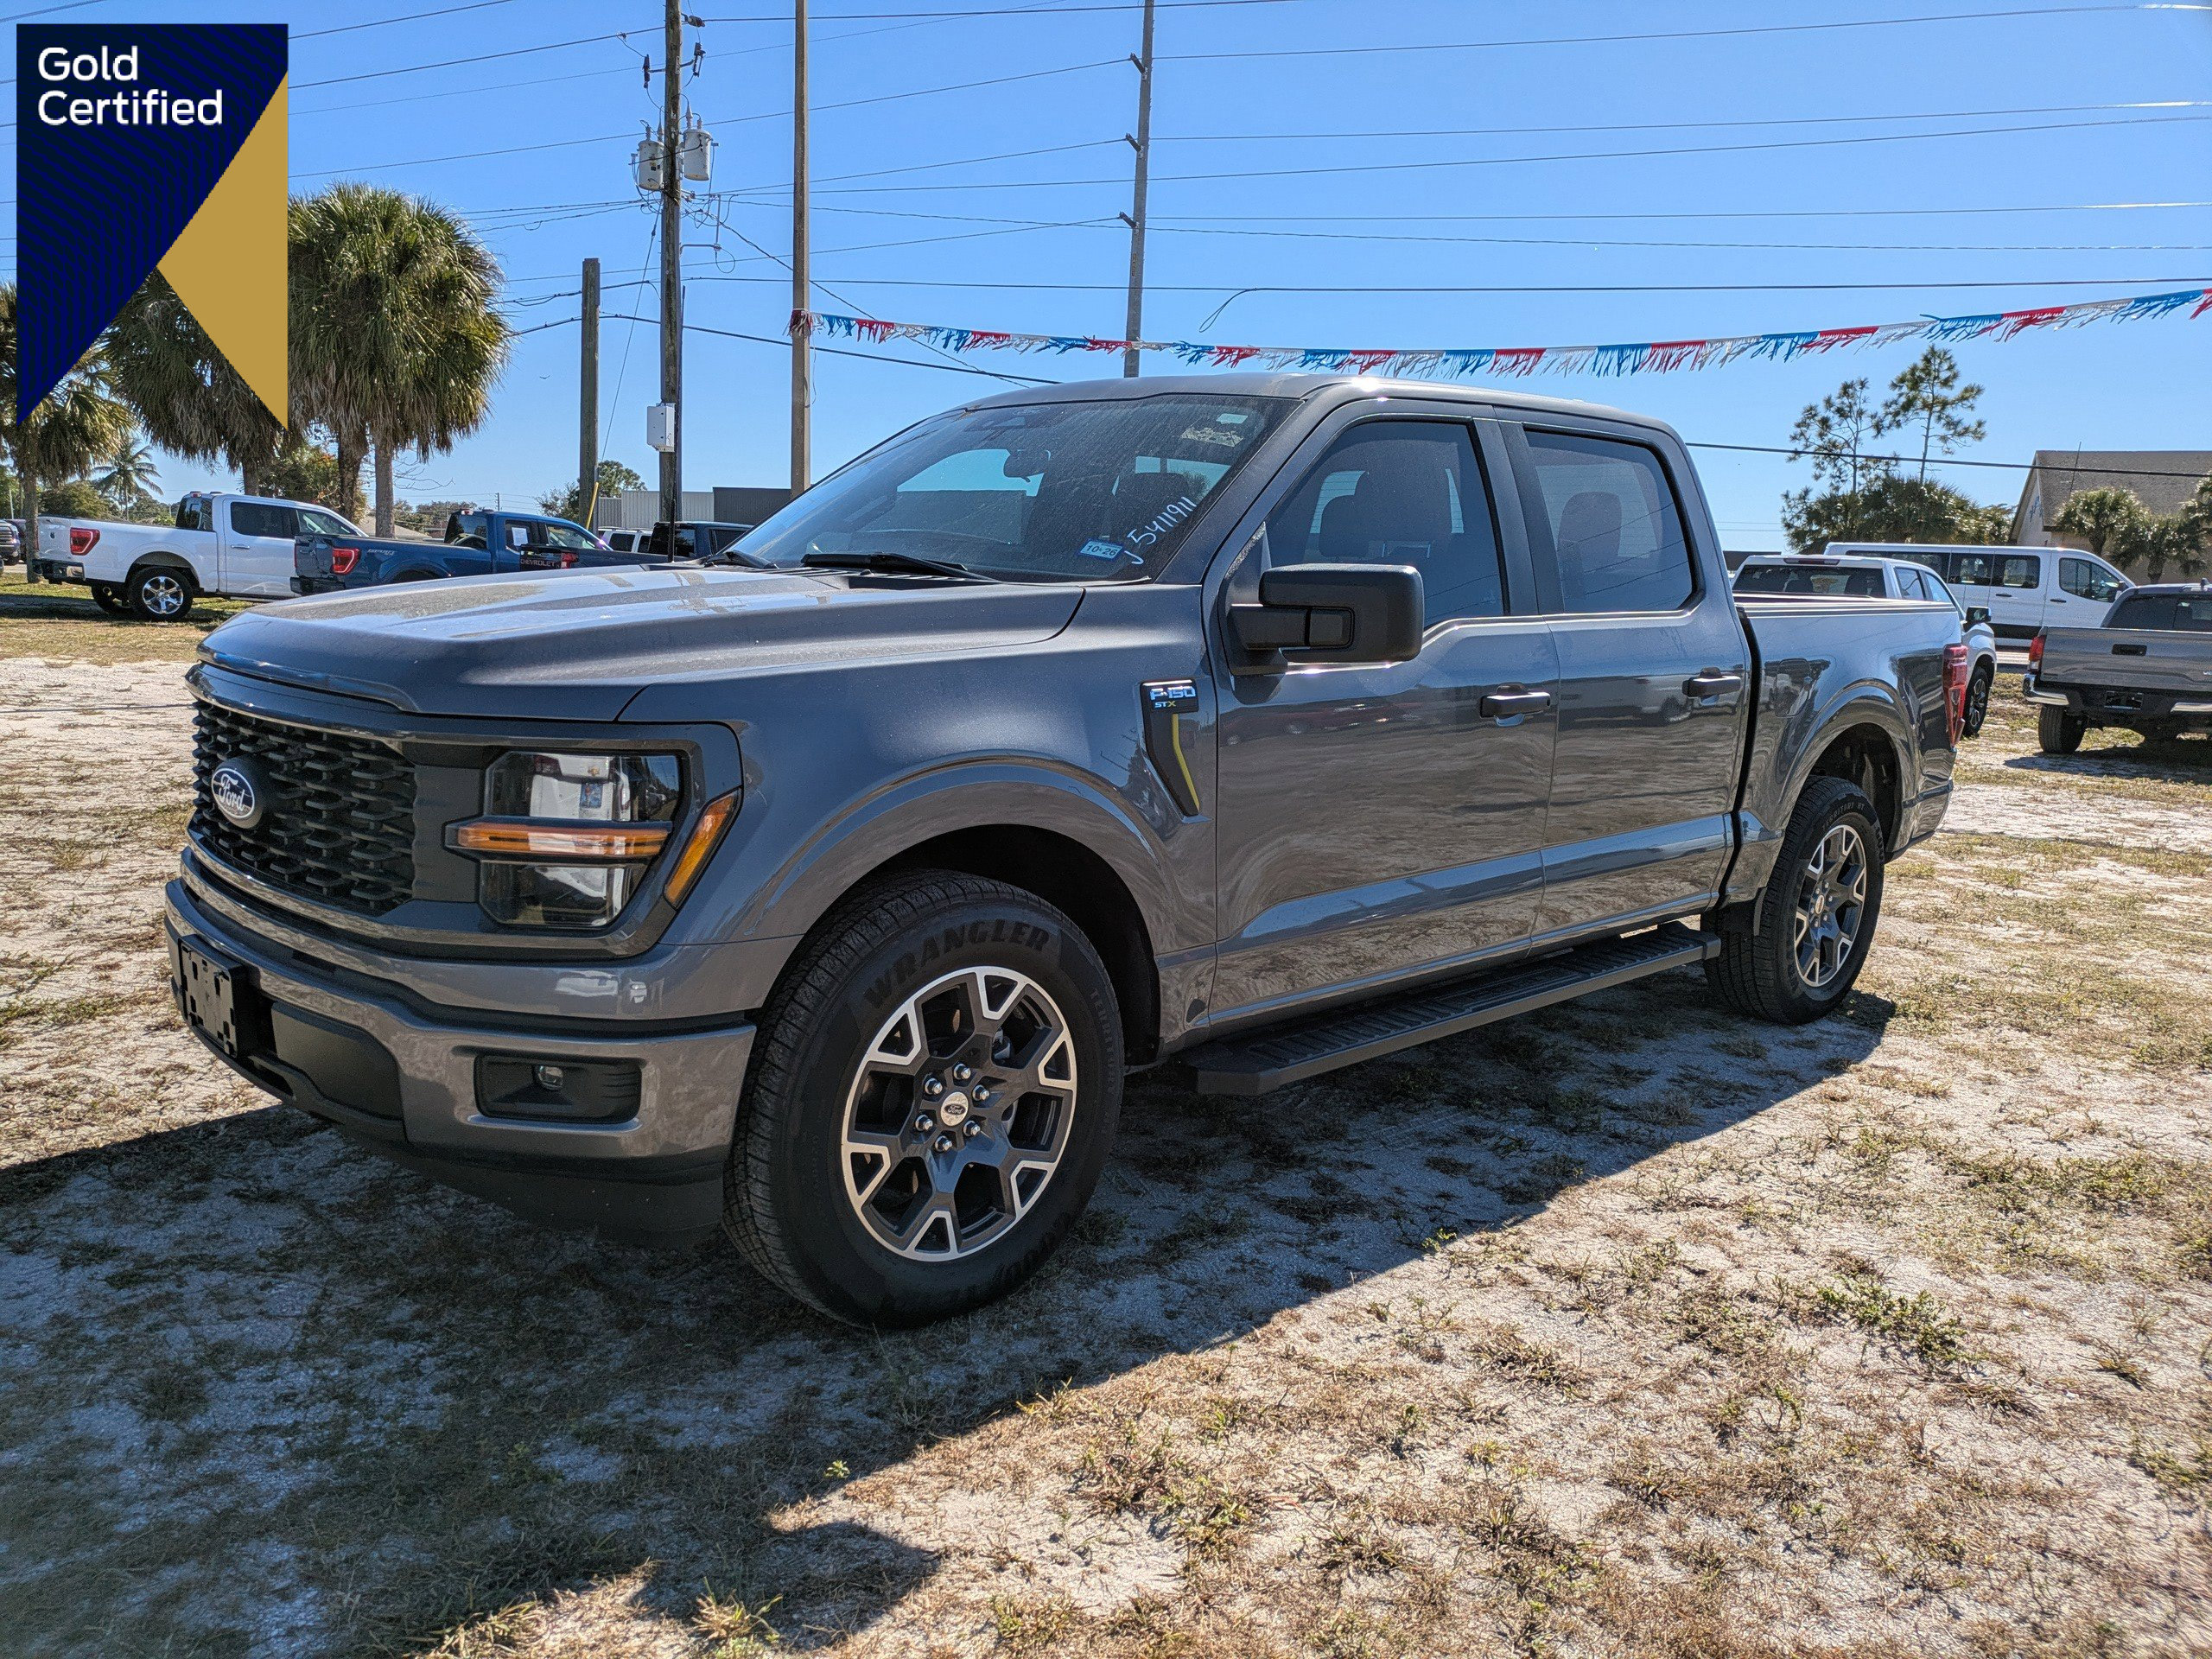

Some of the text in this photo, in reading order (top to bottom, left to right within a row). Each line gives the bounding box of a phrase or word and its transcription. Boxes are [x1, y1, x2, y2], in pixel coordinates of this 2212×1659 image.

[1150, 686, 1196, 701] F-150
[1154, 700, 1176, 709] STX
[864, 918, 1052, 1009] WRANGLER
[946, 1106, 963, 1115] Ford
